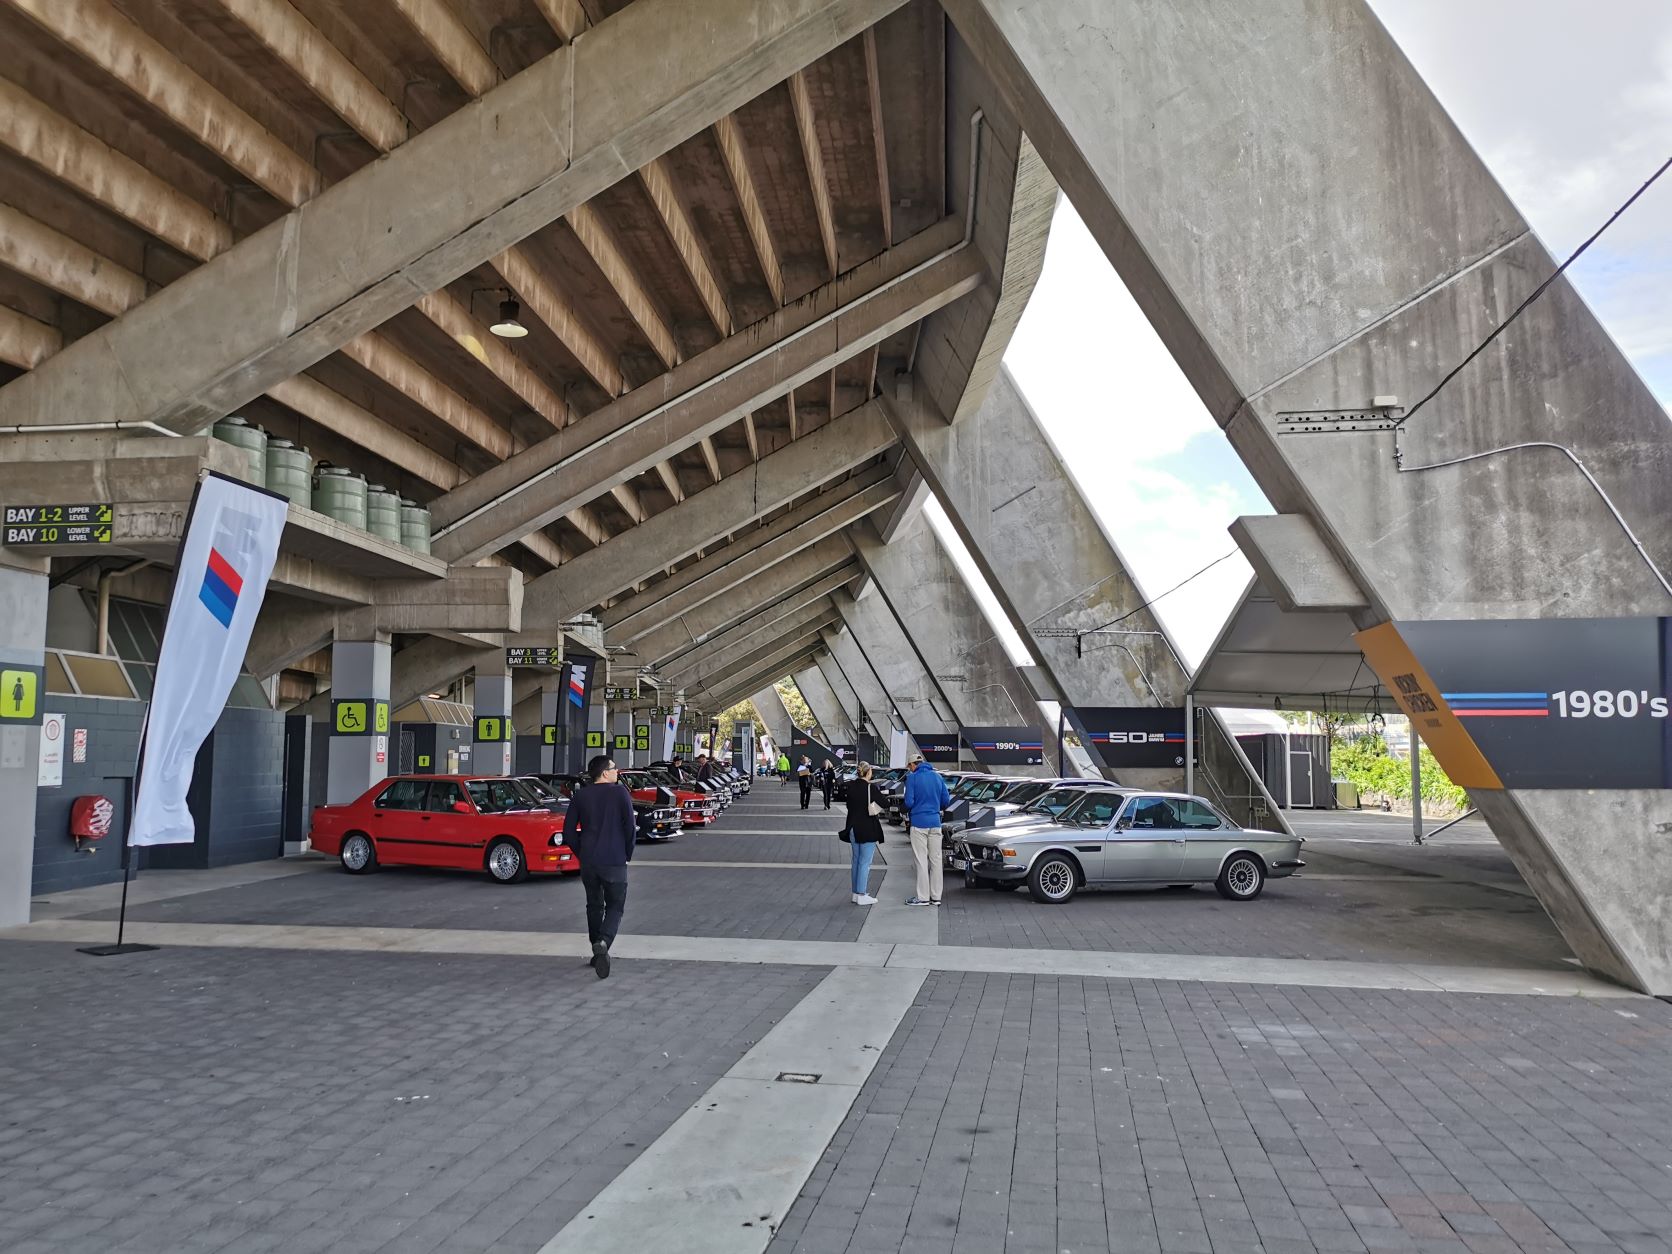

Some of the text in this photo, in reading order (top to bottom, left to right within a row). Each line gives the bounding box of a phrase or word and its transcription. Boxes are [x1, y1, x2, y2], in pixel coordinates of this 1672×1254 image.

[6, 507, 62, 522] BAY 1-2
[7, 528, 58, 542] BAY 10
[510, 648, 531, 656] BAY 3
[1552, 690, 1669, 718] 1980's
[1109, 731, 1147, 743] 50
[995, 742, 1020, 750] 1990's
